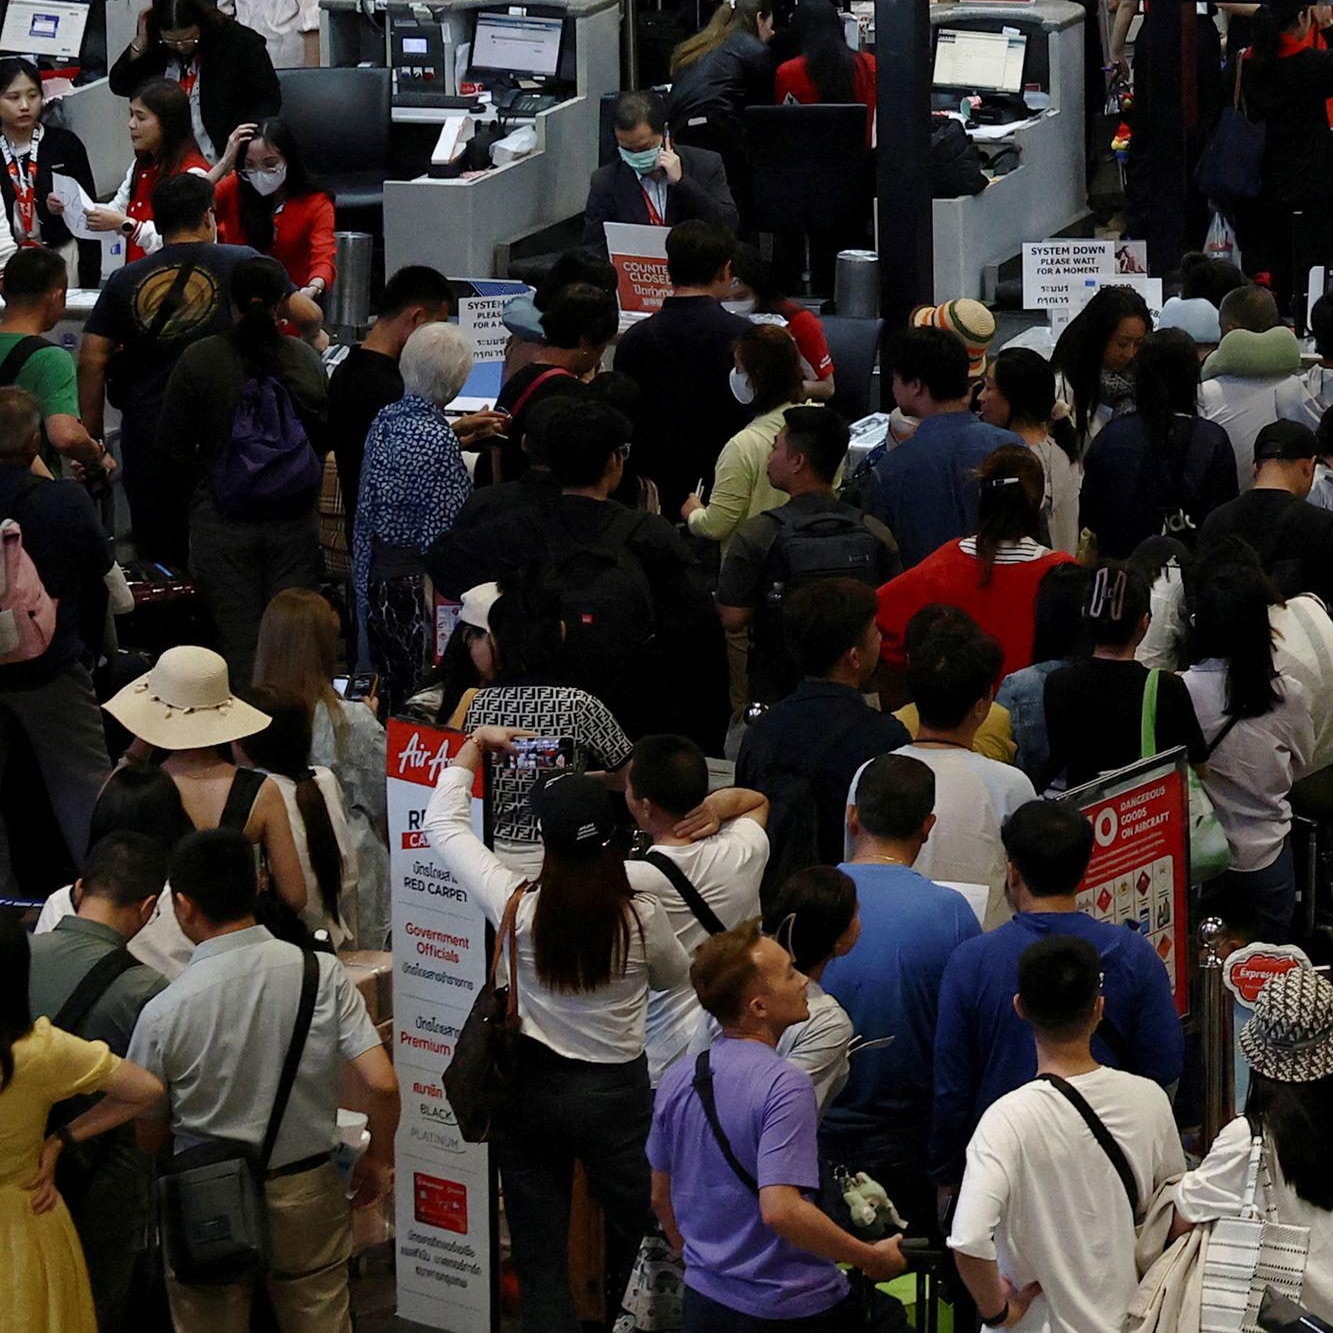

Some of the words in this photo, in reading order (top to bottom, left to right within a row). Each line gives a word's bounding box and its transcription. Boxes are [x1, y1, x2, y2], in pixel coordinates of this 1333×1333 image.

[1031, 246, 1070, 256] SYSTEM
[1072, 245, 1106, 255] DOWN
[622, 261, 669, 275] COUNTE
[1036, 267, 1053, 275] FOR
[1055, 267, 1062, 275] A
[1063, 266, 1101, 275] MOMENT
[1040, 257, 1071, 266] PLEASE
[1072, 257, 1096, 265] WAIT
[477, 312, 502, 320] PLEAS
[1120, 785, 1166, 812] DANGEROUS
[1120, 806, 1148, 826] GOODS
[1121, 829, 1133, 840] ON
[1134, 811, 1170, 835] AIRCRAFT
[404, 876, 426, 893] RED
[405, 922, 470, 950] Government
[416, 941, 460, 964] Officials
[400, 1031, 451, 1057] Premium
[420, 1102, 452, 1120] BLACK
[410, 1126, 459, 1151] PLATINUM
